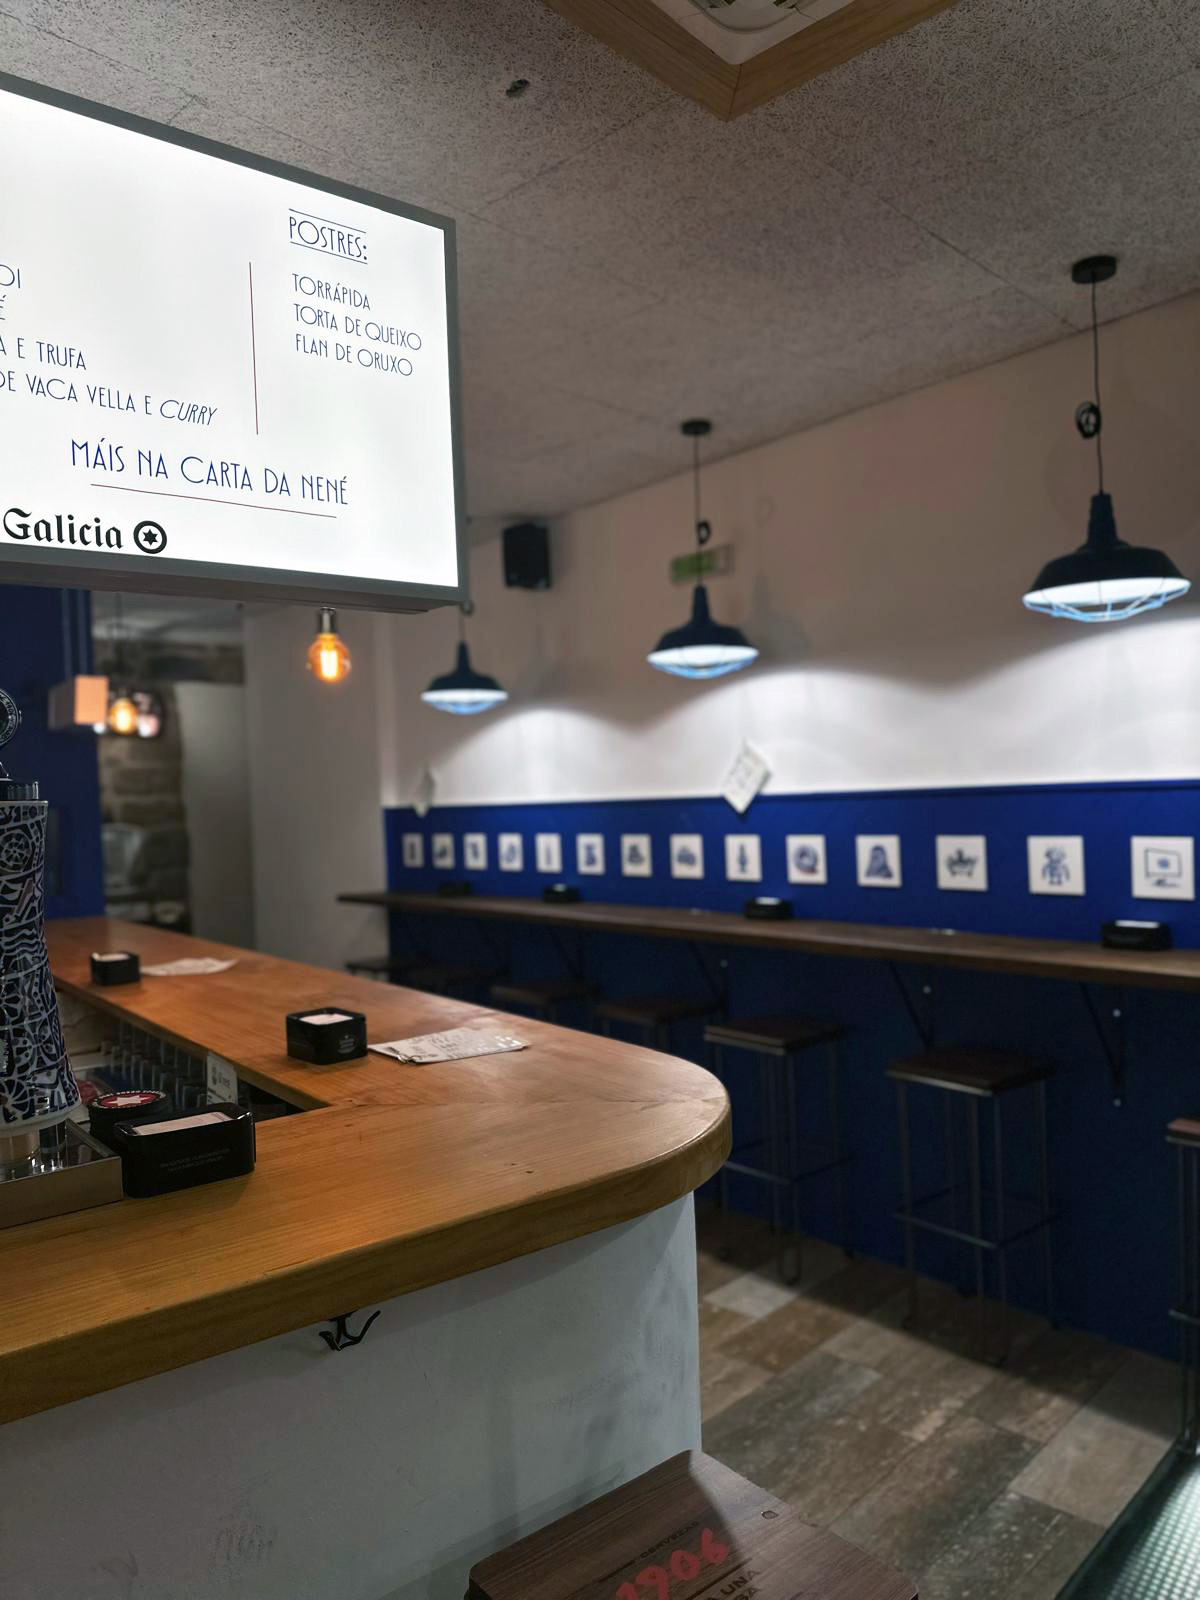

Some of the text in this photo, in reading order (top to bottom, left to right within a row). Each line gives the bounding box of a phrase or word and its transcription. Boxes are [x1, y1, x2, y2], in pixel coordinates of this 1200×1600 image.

[289, 216, 367, 260] POSTRES:
[292, 273, 370, 310] TORRÁPIDA
[294, 303, 422, 350] TORTA DE QUEIXO
[17, 337, 25, 359] E
[36, 341, 87, 370] TRUFA
[296, 333, 413, 376] FLAN DE ORUXO
[26, 373, 78, 402] VACA
[86, 384, 136, 412] VELLA
[145, 395, 152, 415] E
[160, 399, 218, 425] CURRY
[72, 437, 348, 505] MÁIS NA CARTA DA NENÉ
[3, 507, 124, 549] Galicia
